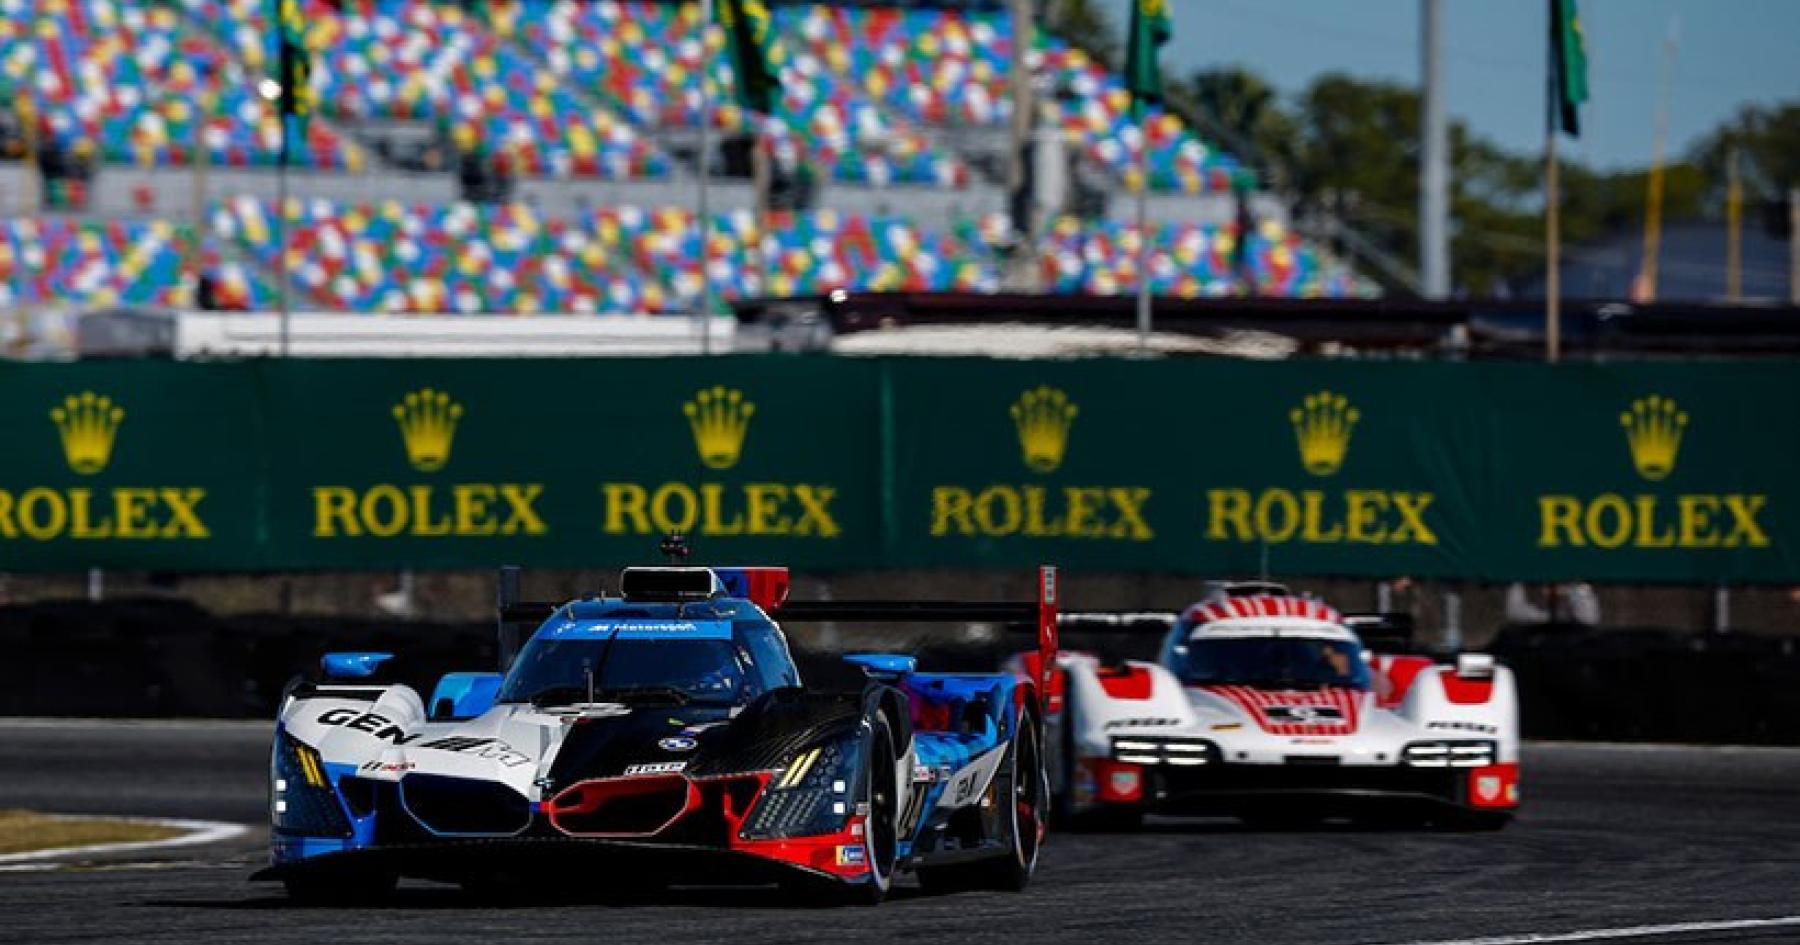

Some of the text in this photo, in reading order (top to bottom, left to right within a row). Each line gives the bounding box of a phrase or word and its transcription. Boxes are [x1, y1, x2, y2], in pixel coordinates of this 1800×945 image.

[313, 483, 546, 538] ROLEX
[603, 483, 839, 538] ROLEX
[931, 485, 1152, 541] ROLEX
[1207, 489, 1437, 545] ROLEX
[1538, 494, 1769, 548] ROLEX
[317, 708, 424, 746] GEN
